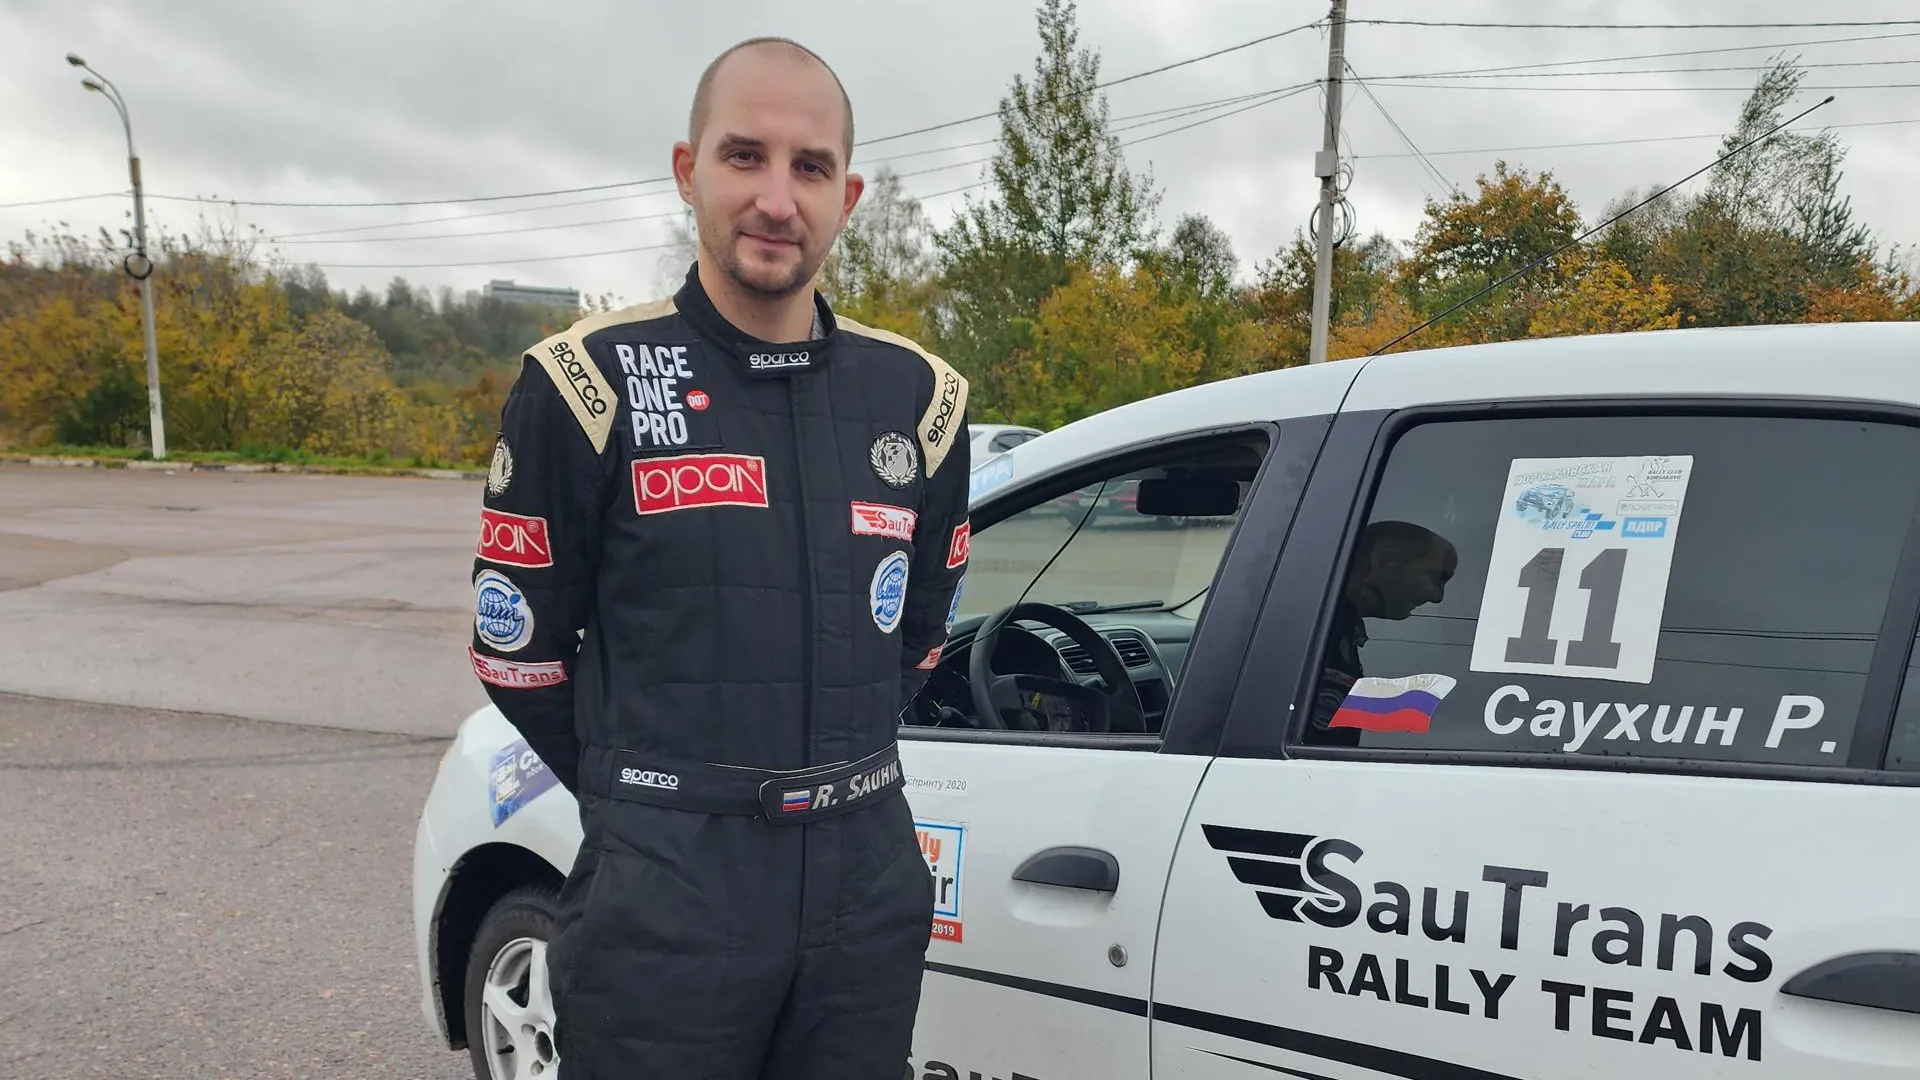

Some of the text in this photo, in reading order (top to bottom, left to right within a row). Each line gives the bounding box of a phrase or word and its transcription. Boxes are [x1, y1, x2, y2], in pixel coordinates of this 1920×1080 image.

[615, 344, 693, 378] RACE
[750, 351, 809, 369] sparco
[550, 342, 606, 416] sparco
[626, 375, 683, 412] ONE
[688, 395, 707, 408] DOT
[928, 372, 958, 445] sparco
[631, 411, 688, 446] PRO
[1542, 520, 1566, 529] RALLY
[1504, 548, 1628, 669] 11
[483, 662, 560, 684] SauTrans
[1484, 685, 1837, 753] Саухин Р.
[620, 767, 678, 790] sparco
[946, 779, 967, 791] 2020
[812, 784, 838, 809] R.
[1299, 838, 1773, 983] SauTrans
[932, 923, 955, 936] 2019
[1307, 944, 1761, 1061] RALLY TEAM
